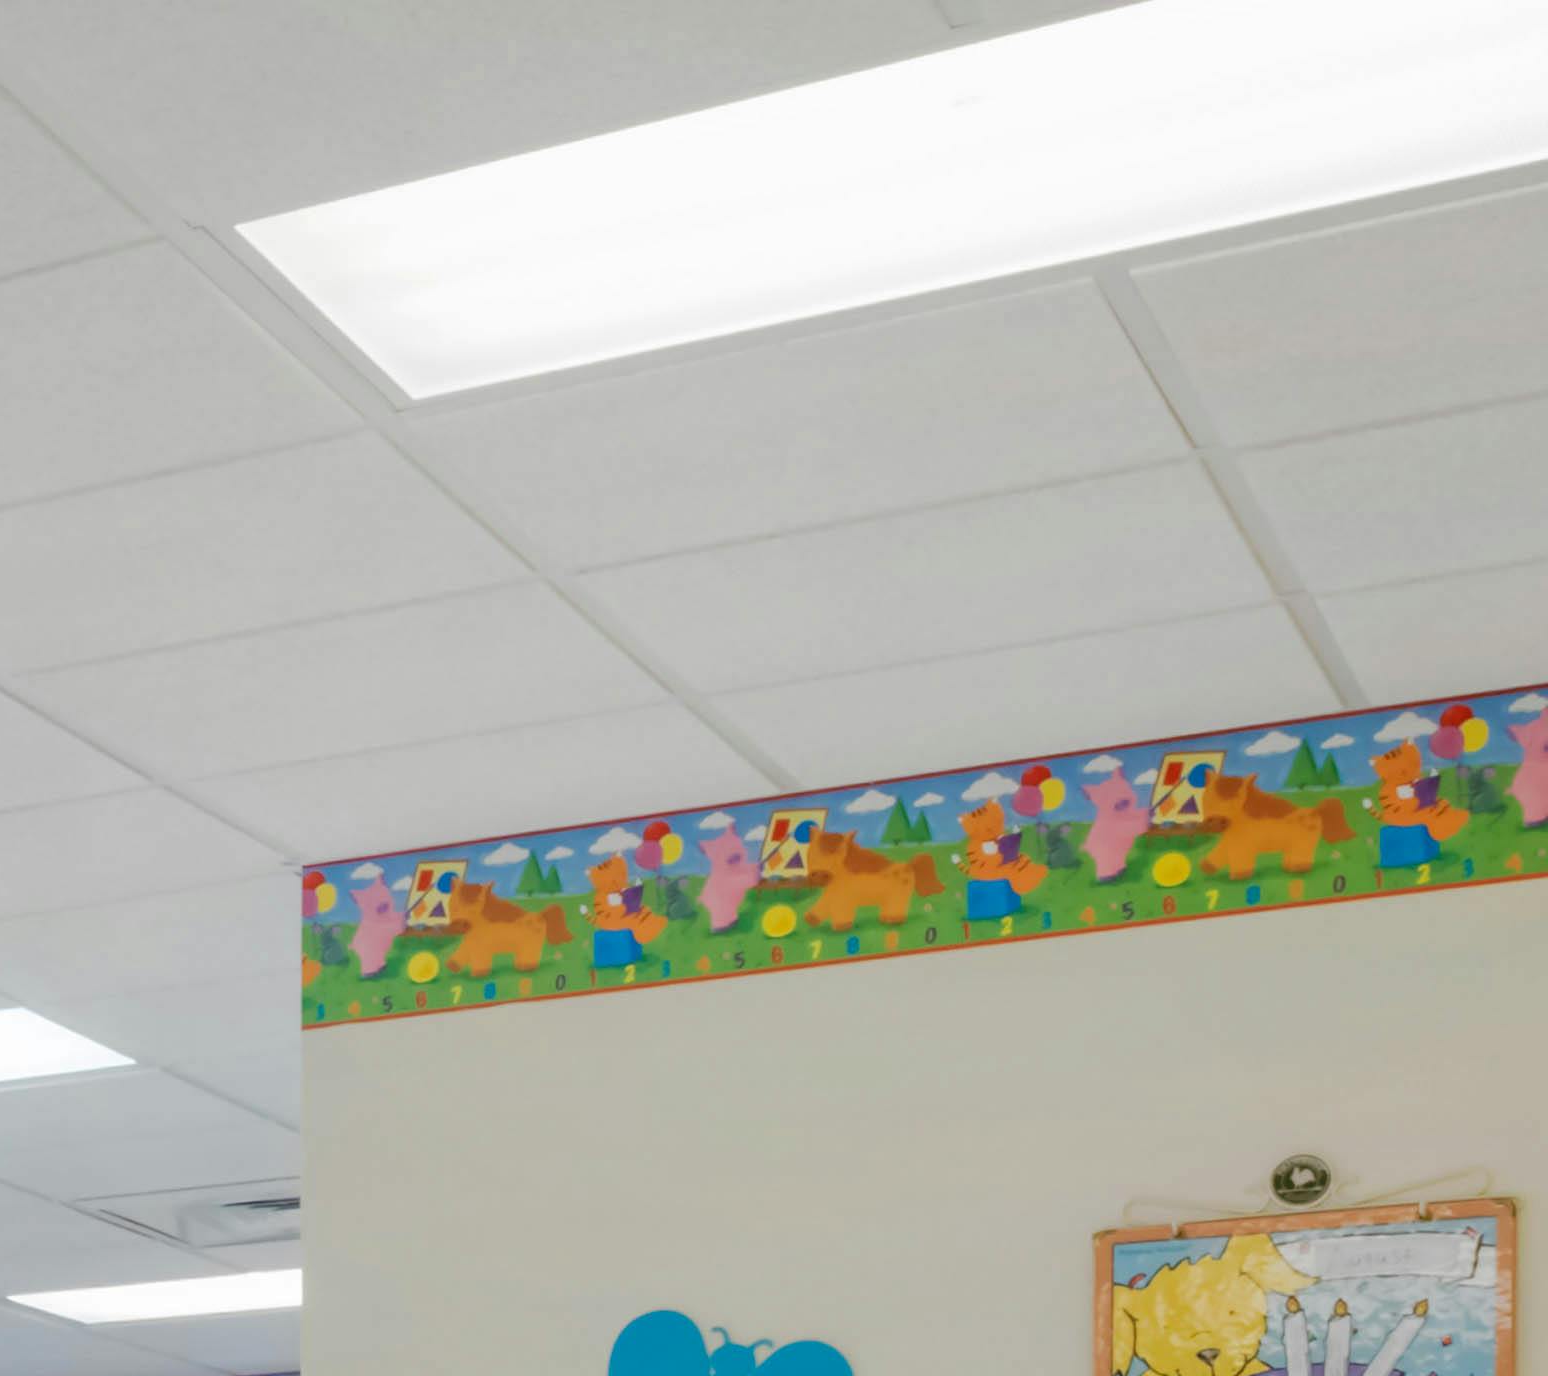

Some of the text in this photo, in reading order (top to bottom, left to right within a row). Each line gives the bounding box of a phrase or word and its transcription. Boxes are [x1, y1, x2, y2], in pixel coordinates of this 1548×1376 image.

[1332, 874, 1346, 893] 0
[1417, 864, 1430, 884] 2
[924, 927, 937, 944] 0
[1000, 916, 1012, 936] 2
[1122, 902, 1134, 920] 5
[1206, 889, 1219, 910] 7
[556, 974, 566, 990] 0
